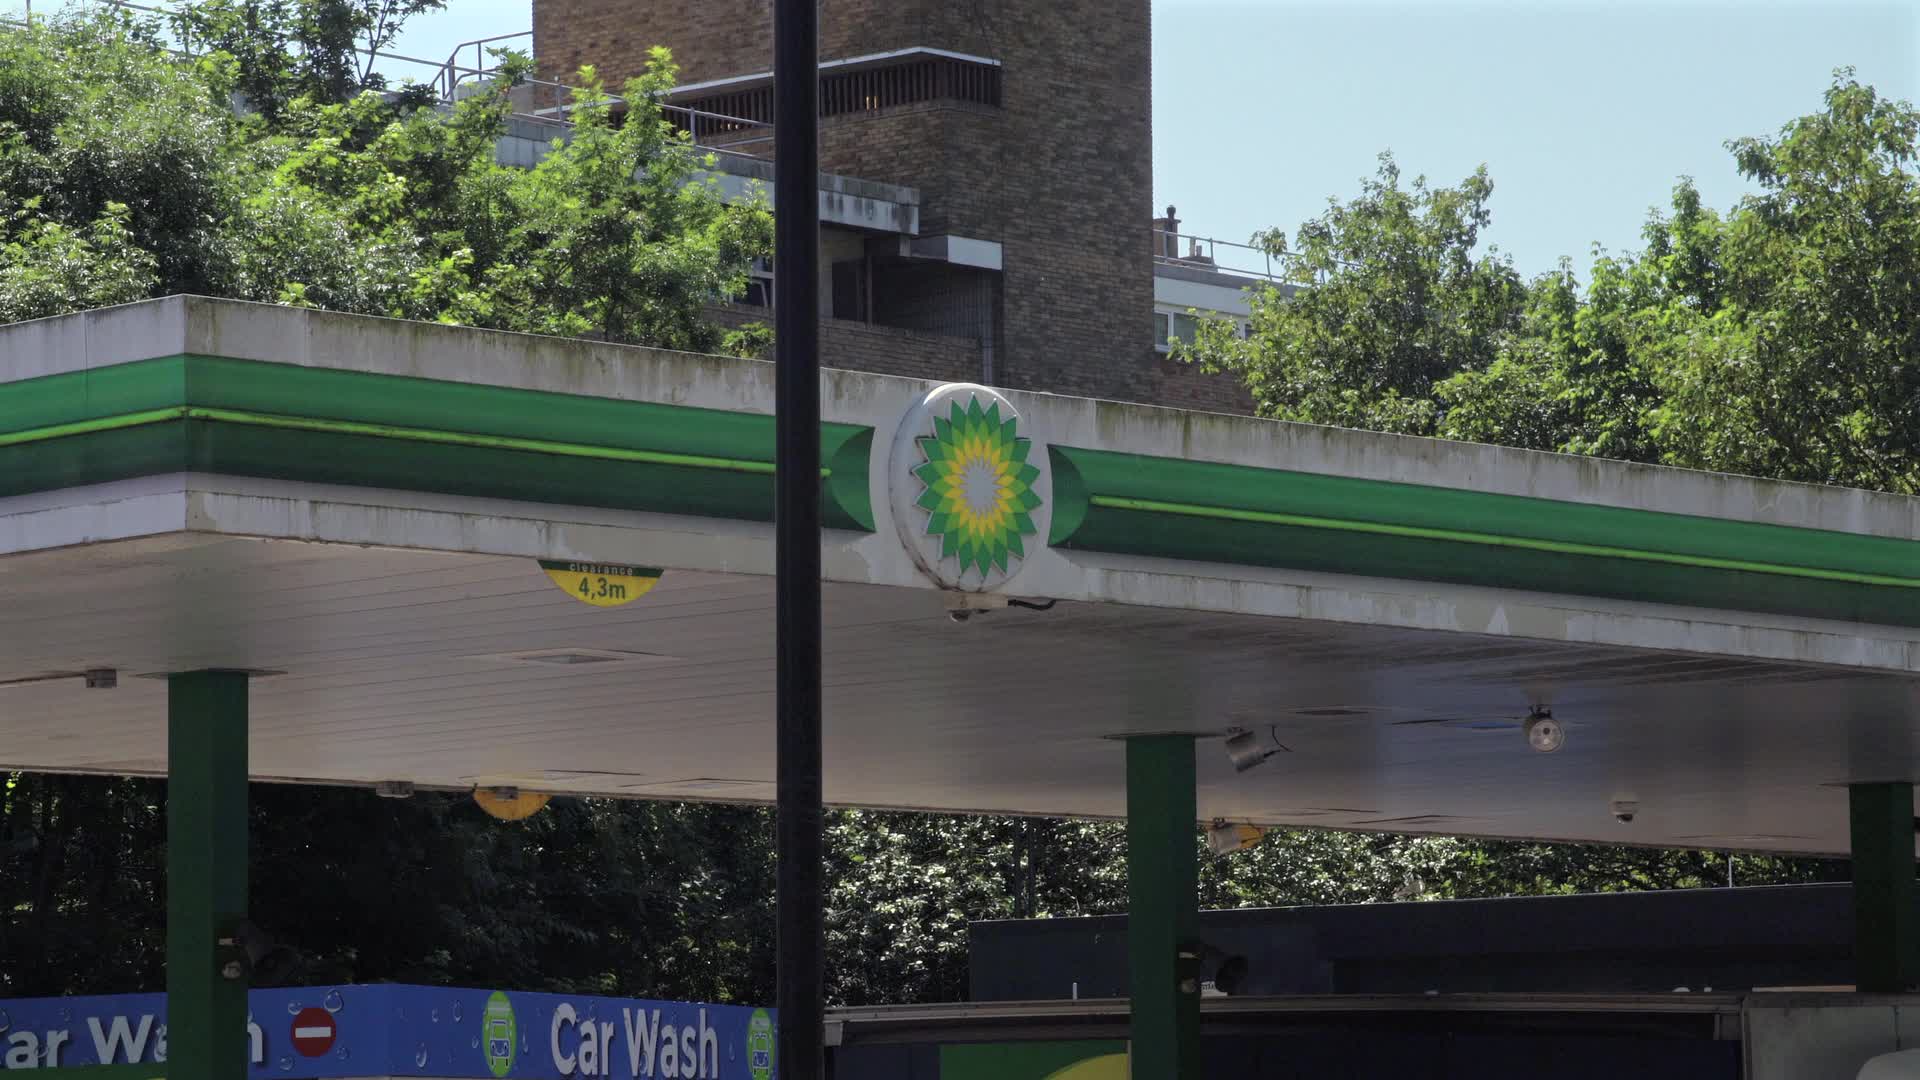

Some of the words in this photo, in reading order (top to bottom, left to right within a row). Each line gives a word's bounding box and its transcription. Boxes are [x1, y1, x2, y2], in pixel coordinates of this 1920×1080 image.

[569, 562, 633, 576] clearance
[578, 577, 626, 600] 4,3m
[0, 1029, 69, 1070] ar
[551, 1002, 614, 1076] Car
[623, 1007, 718, 1079] Wash
